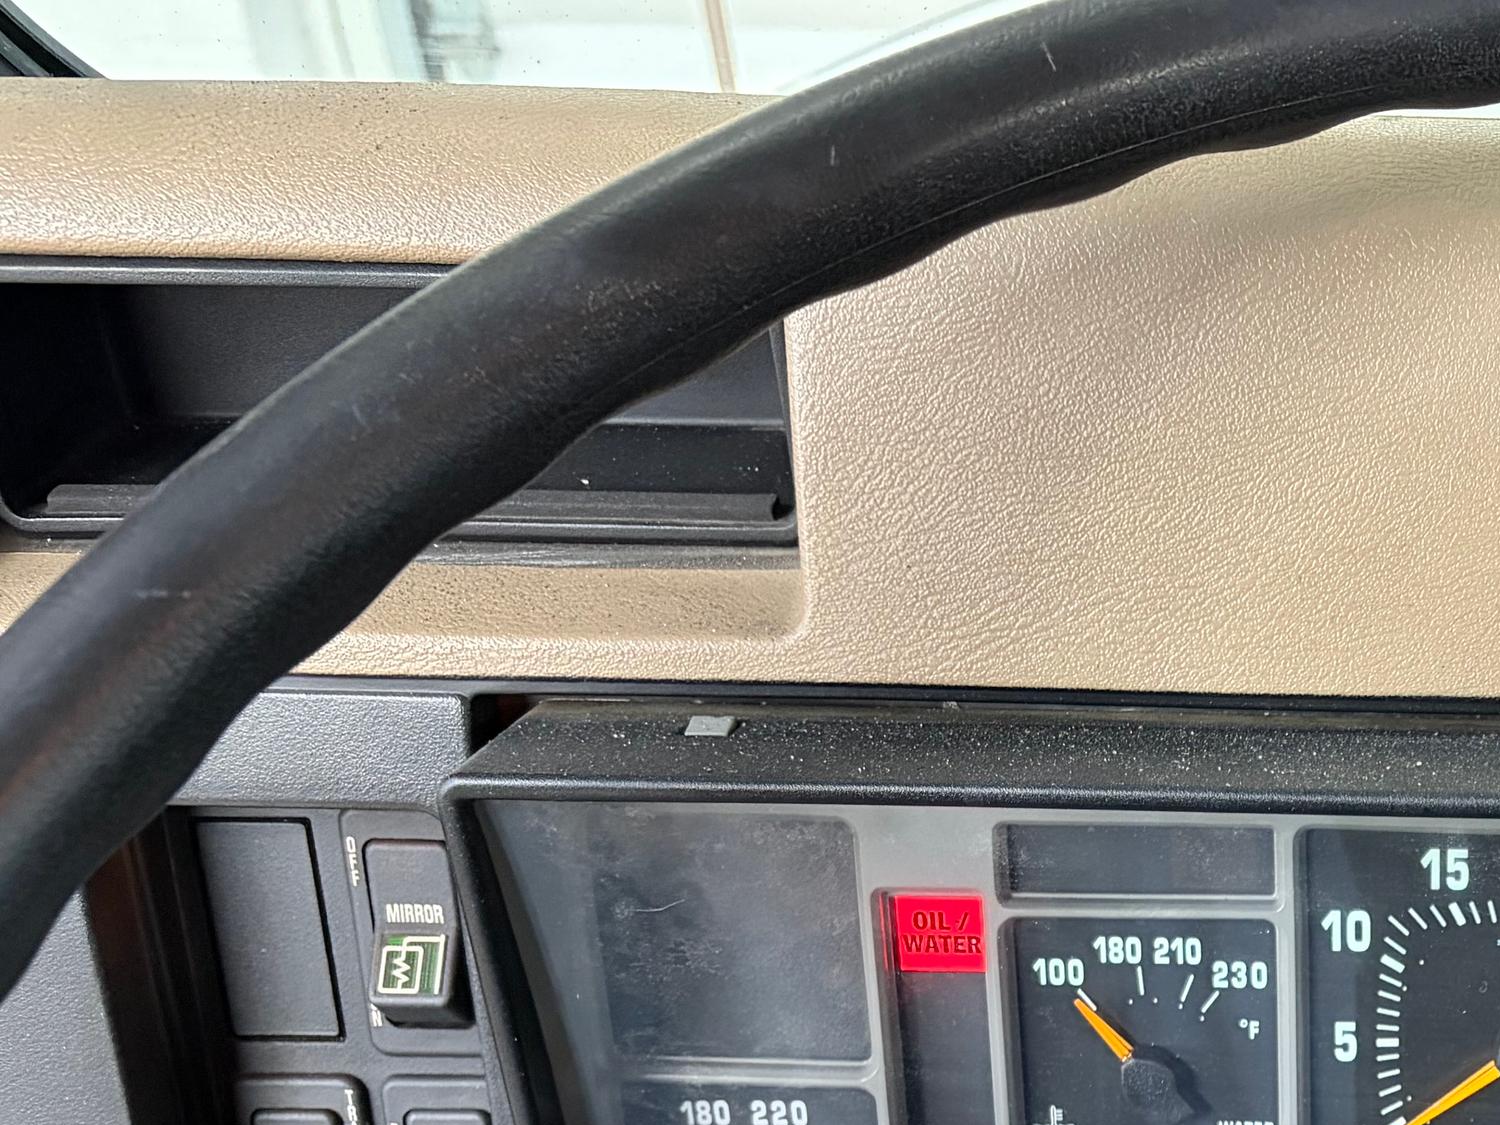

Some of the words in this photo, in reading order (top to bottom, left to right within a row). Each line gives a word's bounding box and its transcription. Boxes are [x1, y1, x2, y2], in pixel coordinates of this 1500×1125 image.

[346, 836, 360, 886] OFF
[1421, 848, 1470, 891] 15
[386, 903, 444, 924] MIRROR
[903, 934, 982, 954] WATER
[1321, 910, 1371, 952] 10
[1093, 936, 1142, 964] 180
[1153, 937, 1201, 965] 210
[1033, 958, 1084, 986] 100
[1212, 961, 1267, 989] 230
[1333, 1021, 1357, 1062] 5
